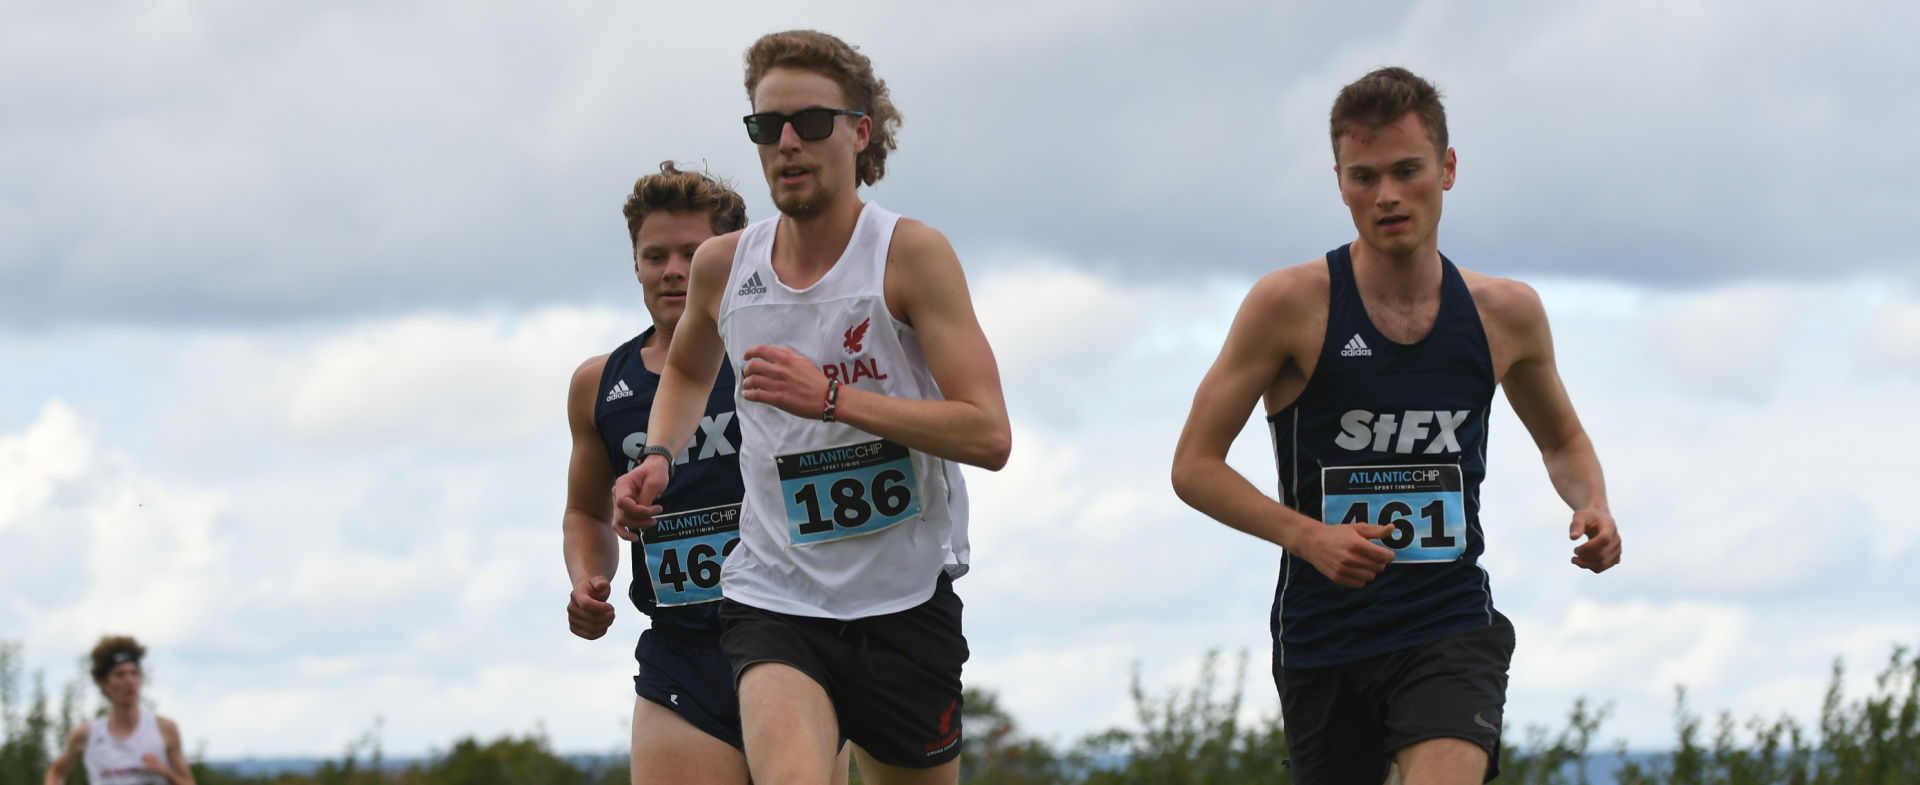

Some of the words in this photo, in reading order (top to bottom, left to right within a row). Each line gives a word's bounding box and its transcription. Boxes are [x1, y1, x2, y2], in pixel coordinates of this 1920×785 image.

[738, 285, 767, 296] adidas
[1341, 348, 1372, 356] adidas
[606, 389, 633, 402] adidas
[1334, 410, 1470, 454] StFX
[822, 463, 840, 471] SPORT
[841, 461, 860, 469] TIMING
[794, 469, 912, 536] 186
[658, 536, 741, 593] 46
